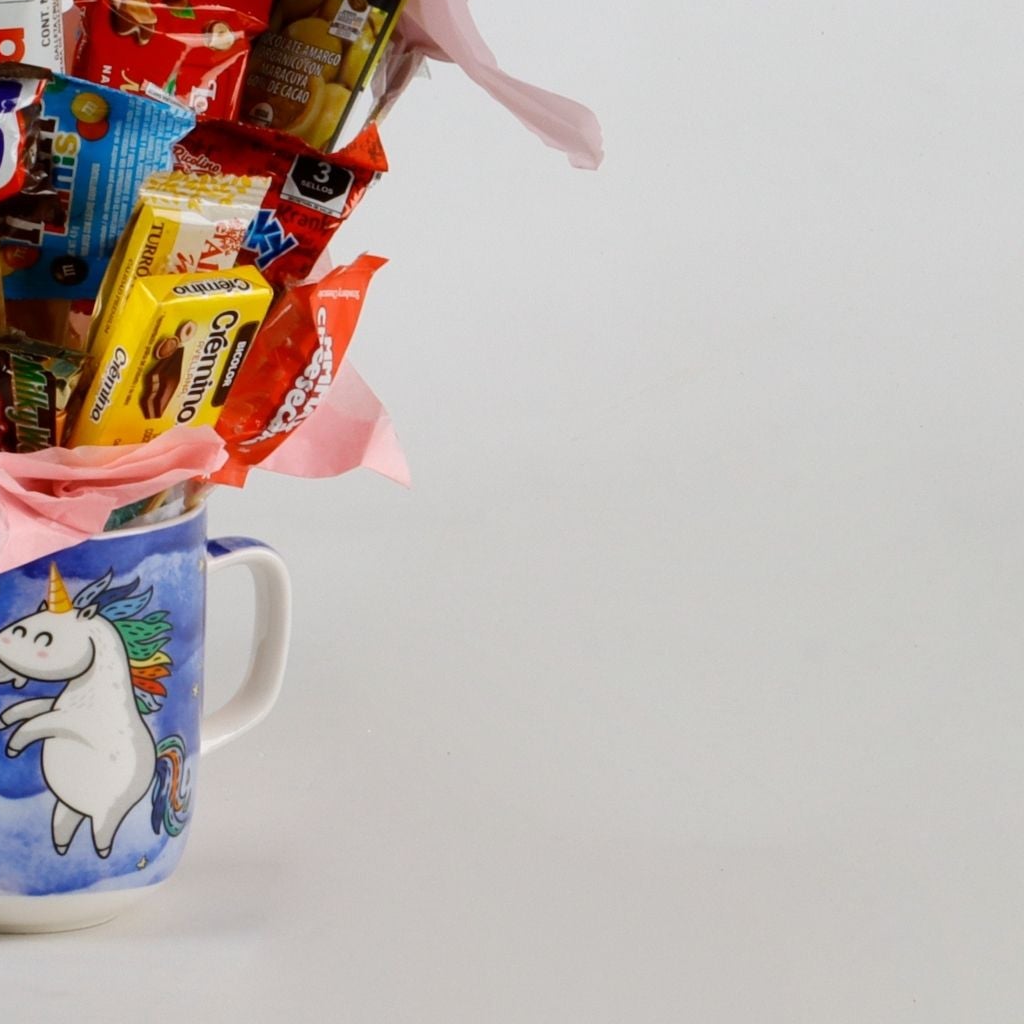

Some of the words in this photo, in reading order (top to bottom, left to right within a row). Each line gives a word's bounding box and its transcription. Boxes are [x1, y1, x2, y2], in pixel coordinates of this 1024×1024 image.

[41, 13, 50, 47] CONT.
[301, 42, 342, 68] AMARGO
[302, 59, 324, 77] CON
[266, 78, 281, 95] DE
[278, 82, 311, 105] CACAO
[174, 144, 222, 172] Ricolino
[312, 162, 331, 184] 3
[301, 179, 334, 195] SELLOS
[135, 222, 166, 276] TURRÓ
[173, 278, 251, 296] Crémino
[176, 310, 239, 424] Crémino
[223, 340, 248, 388] BICOLOR
[90, 348, 128, 424] Crémino
